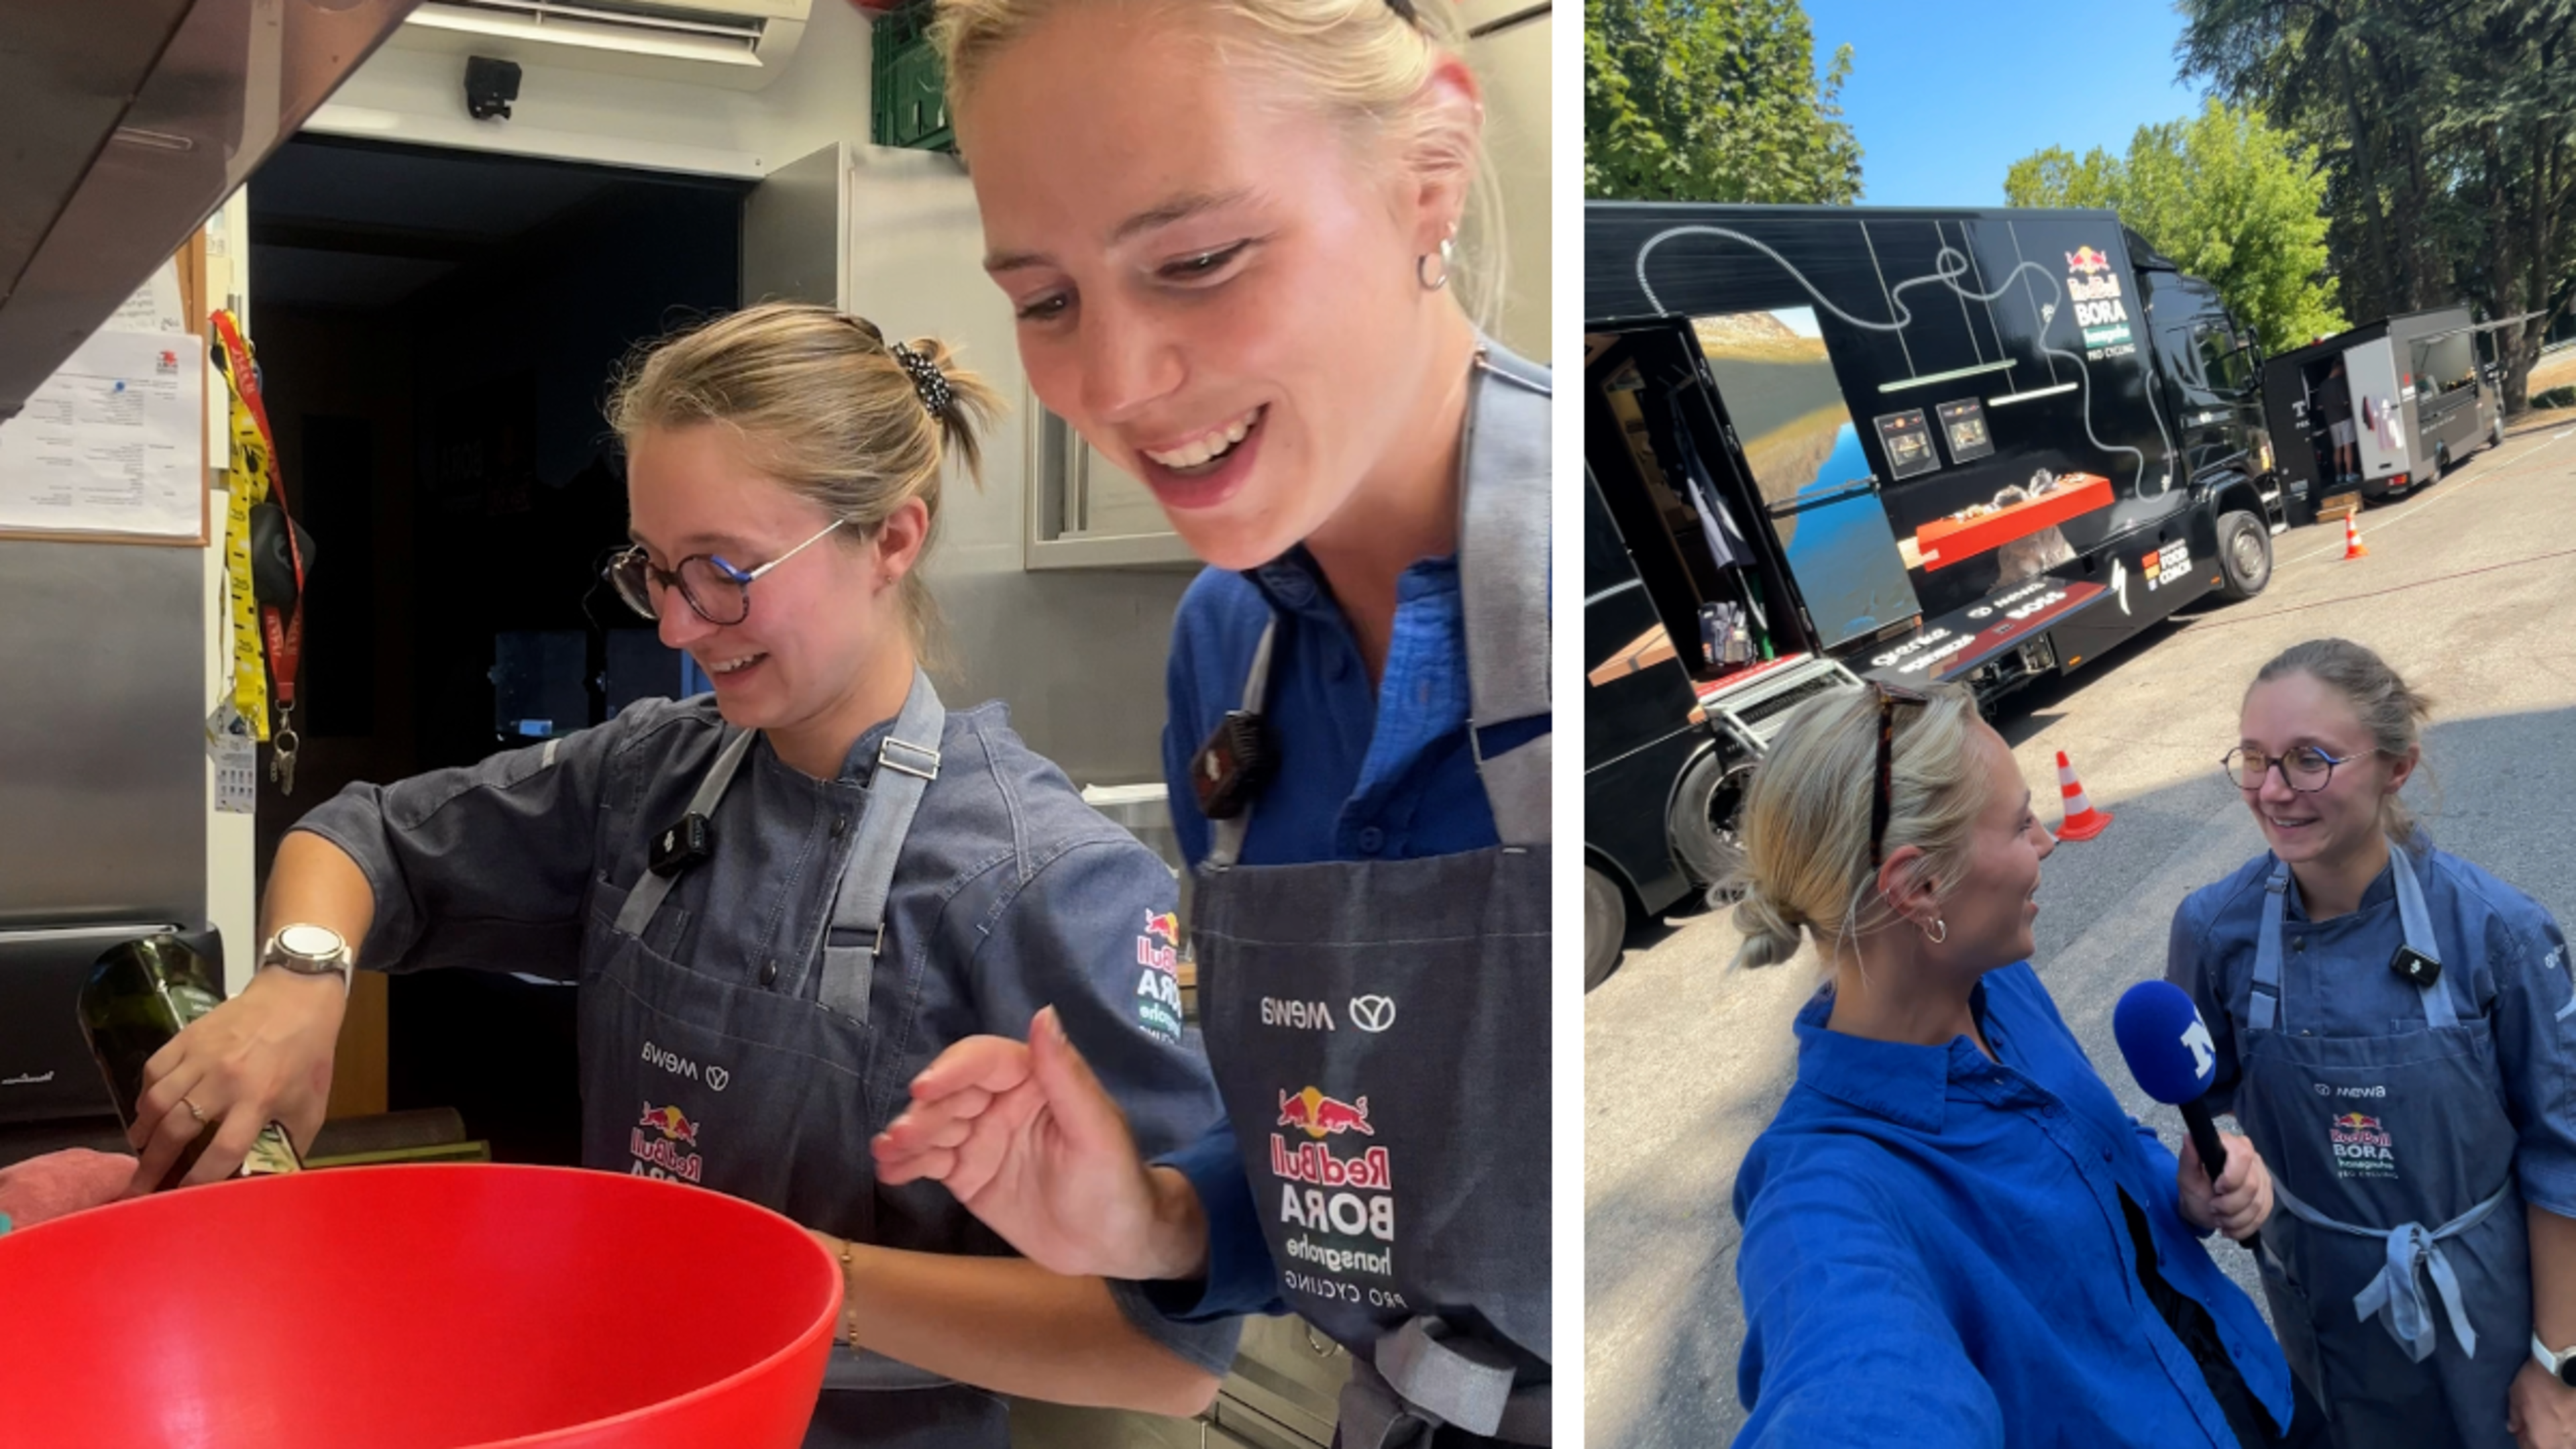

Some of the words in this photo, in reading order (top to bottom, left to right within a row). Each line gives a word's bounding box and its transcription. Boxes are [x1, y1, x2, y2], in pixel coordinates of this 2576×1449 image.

[2074, 299, 2127, 327] BORA
[2160, 546, 2188, 570] FOOD
[2332, 1143, 2394, 1161] BORA
